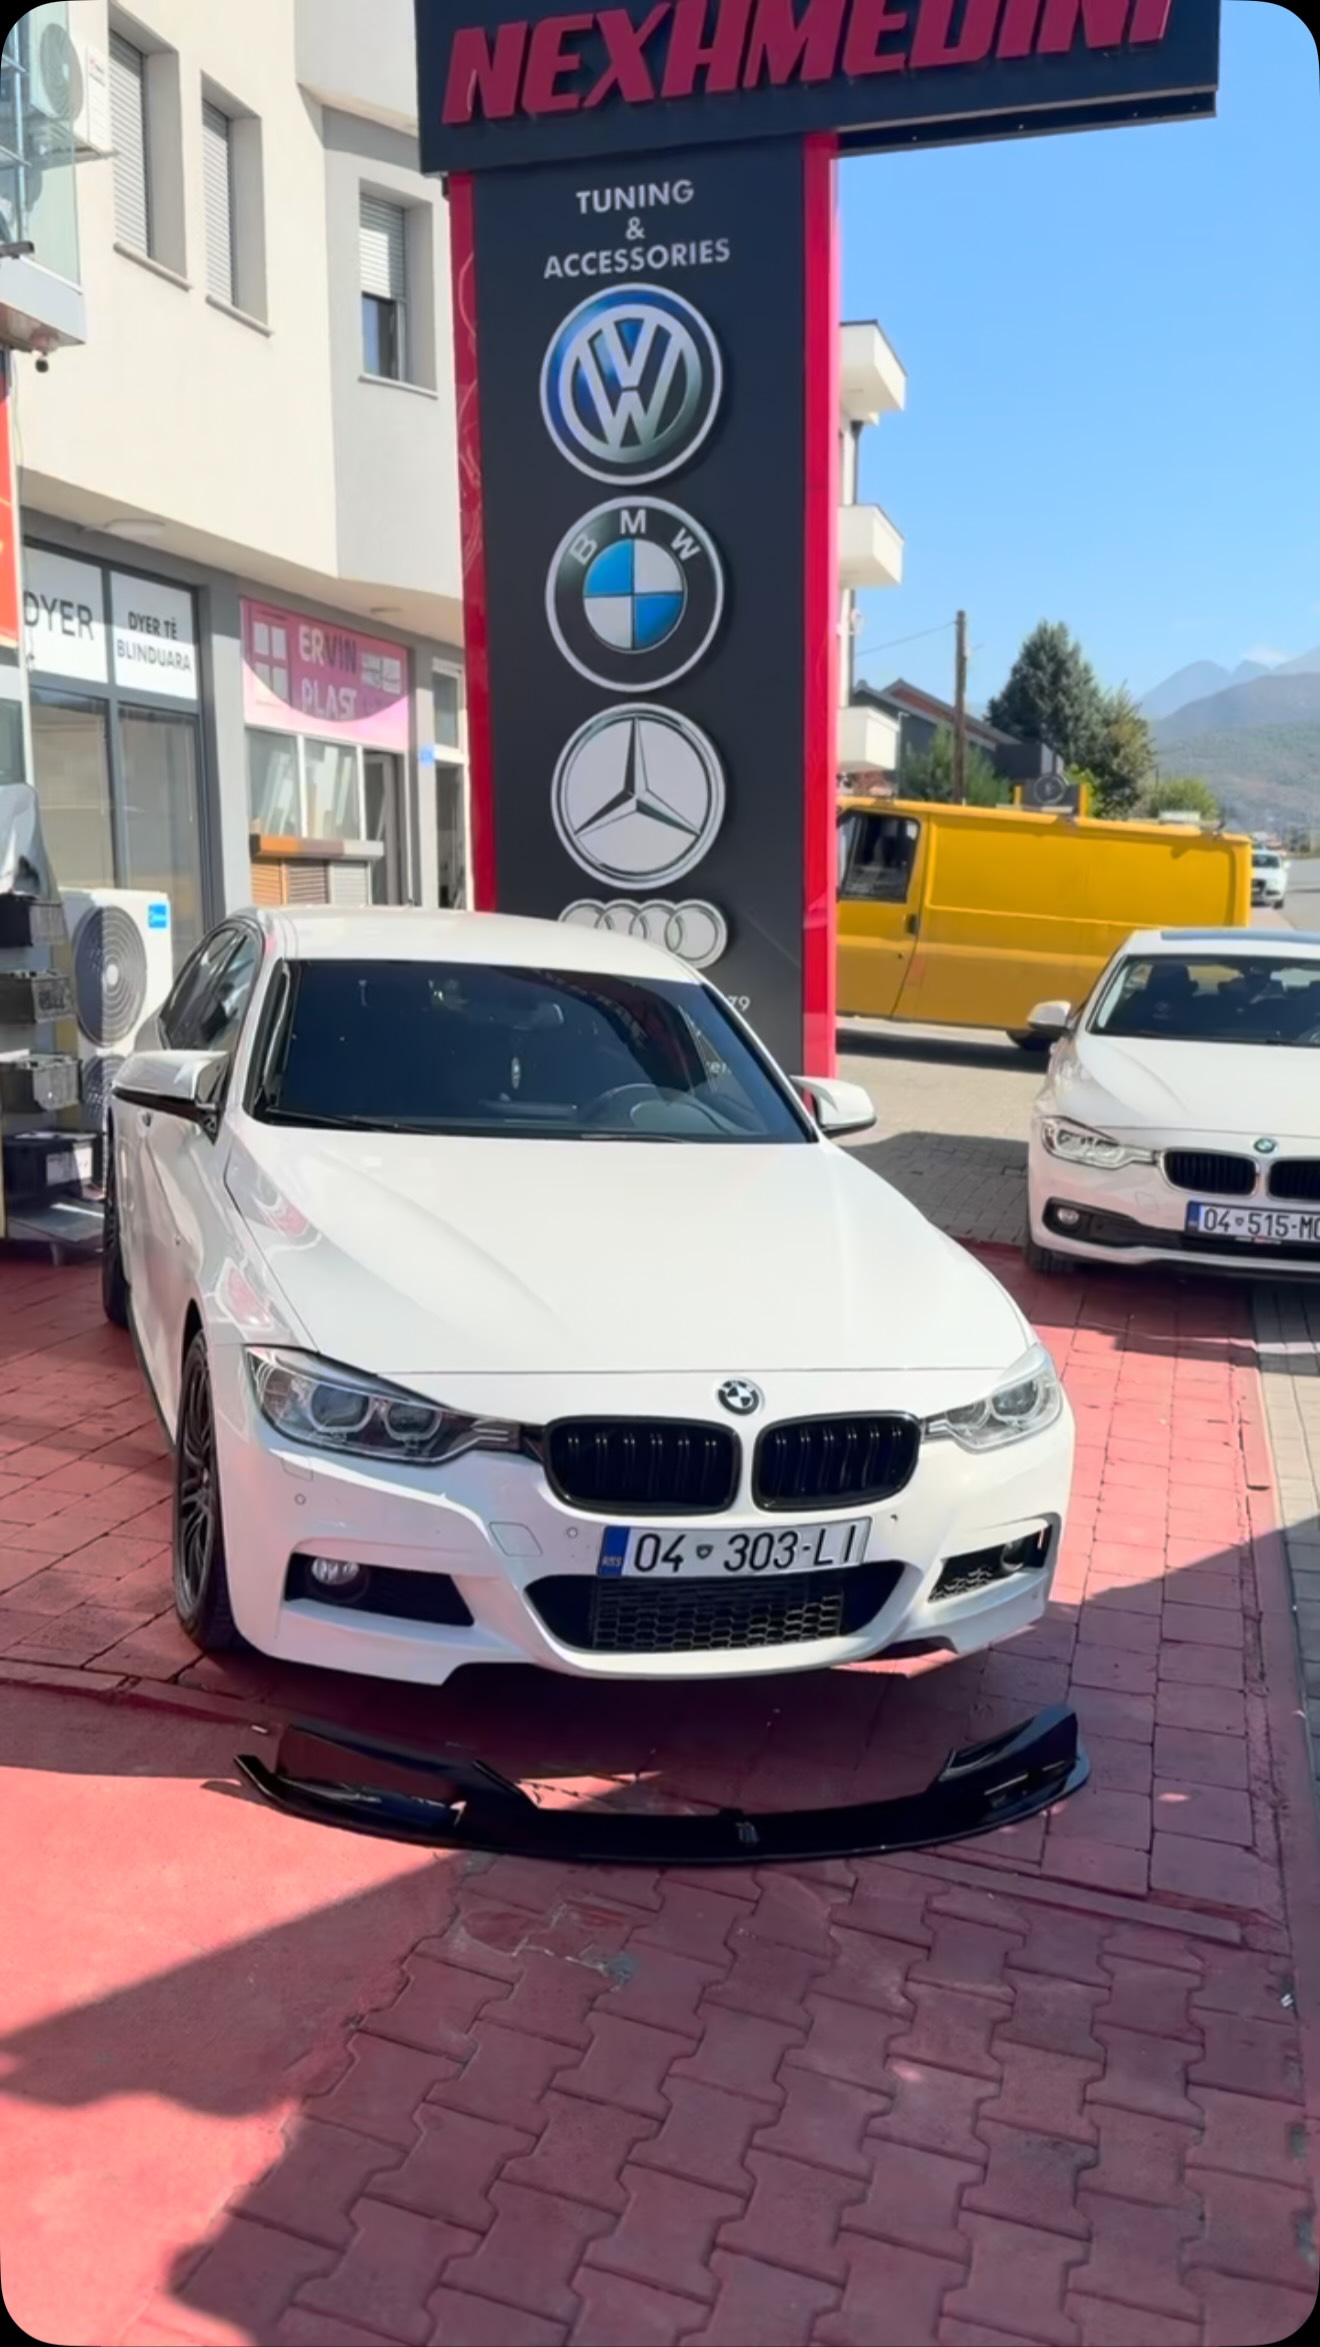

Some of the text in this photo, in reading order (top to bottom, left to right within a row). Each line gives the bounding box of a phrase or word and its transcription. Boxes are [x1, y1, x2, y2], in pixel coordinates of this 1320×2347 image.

[576, 179, 695, 215] TUNING
[625, 216, 645, 241] &
[543, 238, 731, 280] ACCESSORIES
[23, 590, 95, 641] DYER
[128, 611, 161, 636] DYER
[116, 638, 192, 671] BLINDUARA
[299, 623, 358, 675] ERVIN
[301, 676, 358, 721] PLAST
